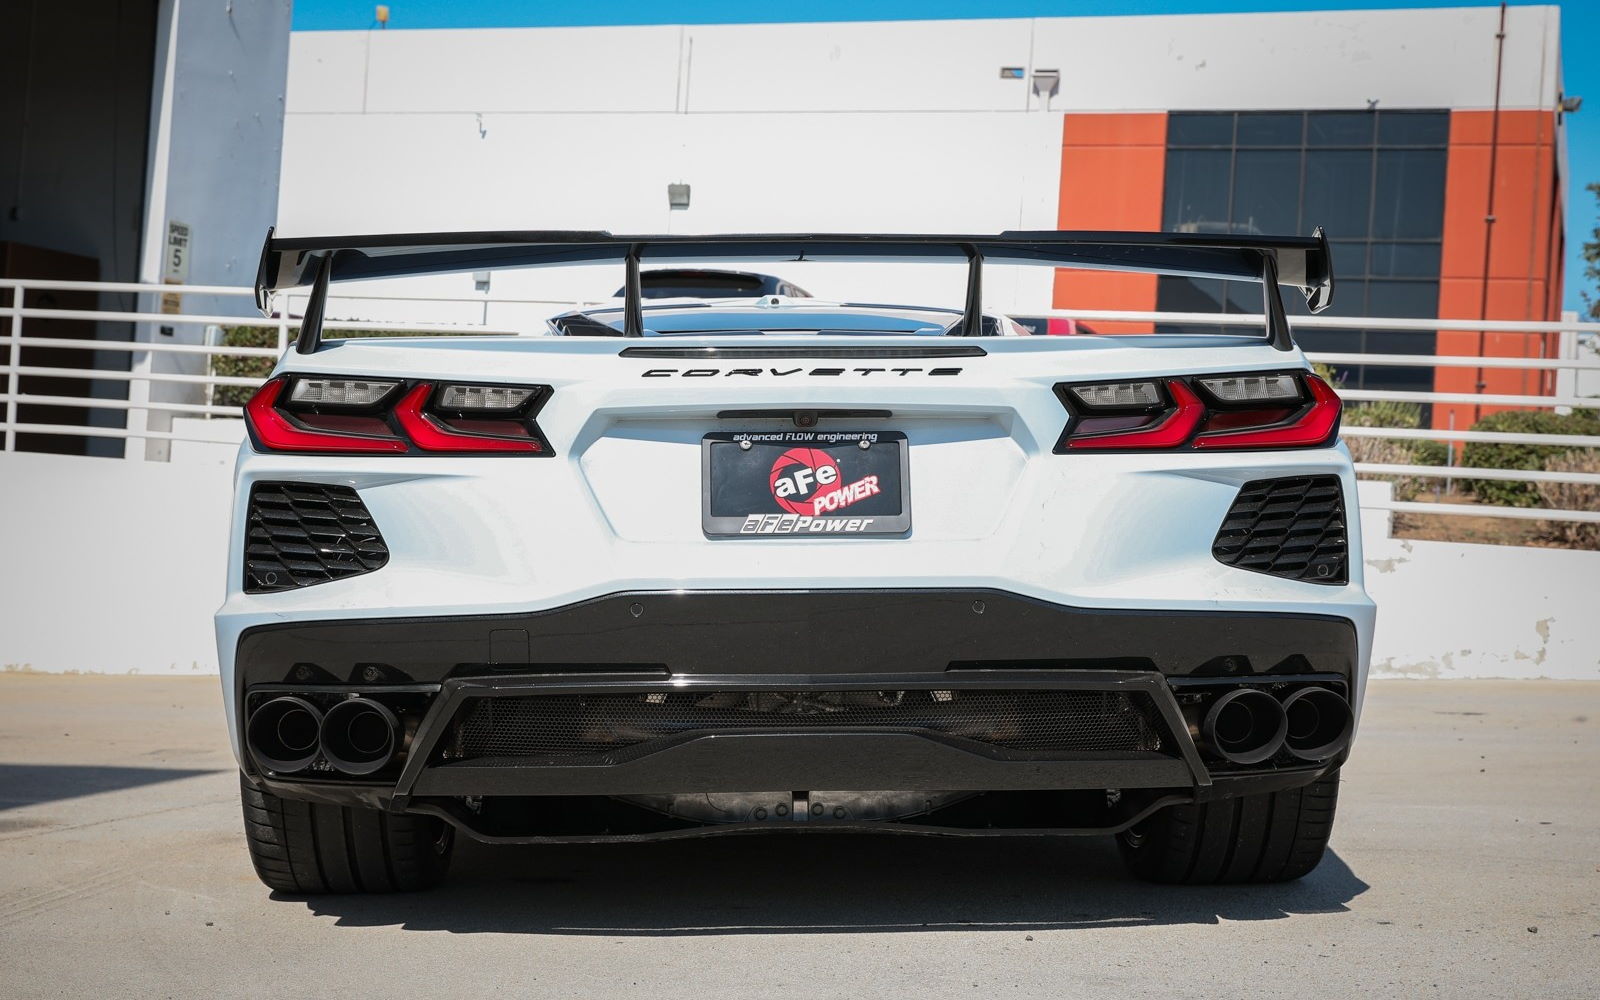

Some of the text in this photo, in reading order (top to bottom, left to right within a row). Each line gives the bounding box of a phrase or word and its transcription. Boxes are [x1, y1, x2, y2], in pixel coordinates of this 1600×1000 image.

[169, 223, 189, 236] SPEED
[168, 236, 188, 248] LIMIT
[173, 249, 182, 267] 5
[641, 368, 963, 378] CORVETTE
[733, 432, 878, 443] advanced FLOW engineering
[774, 464, 838, 498] aFe
[814, 475, 880, 516] POWER
